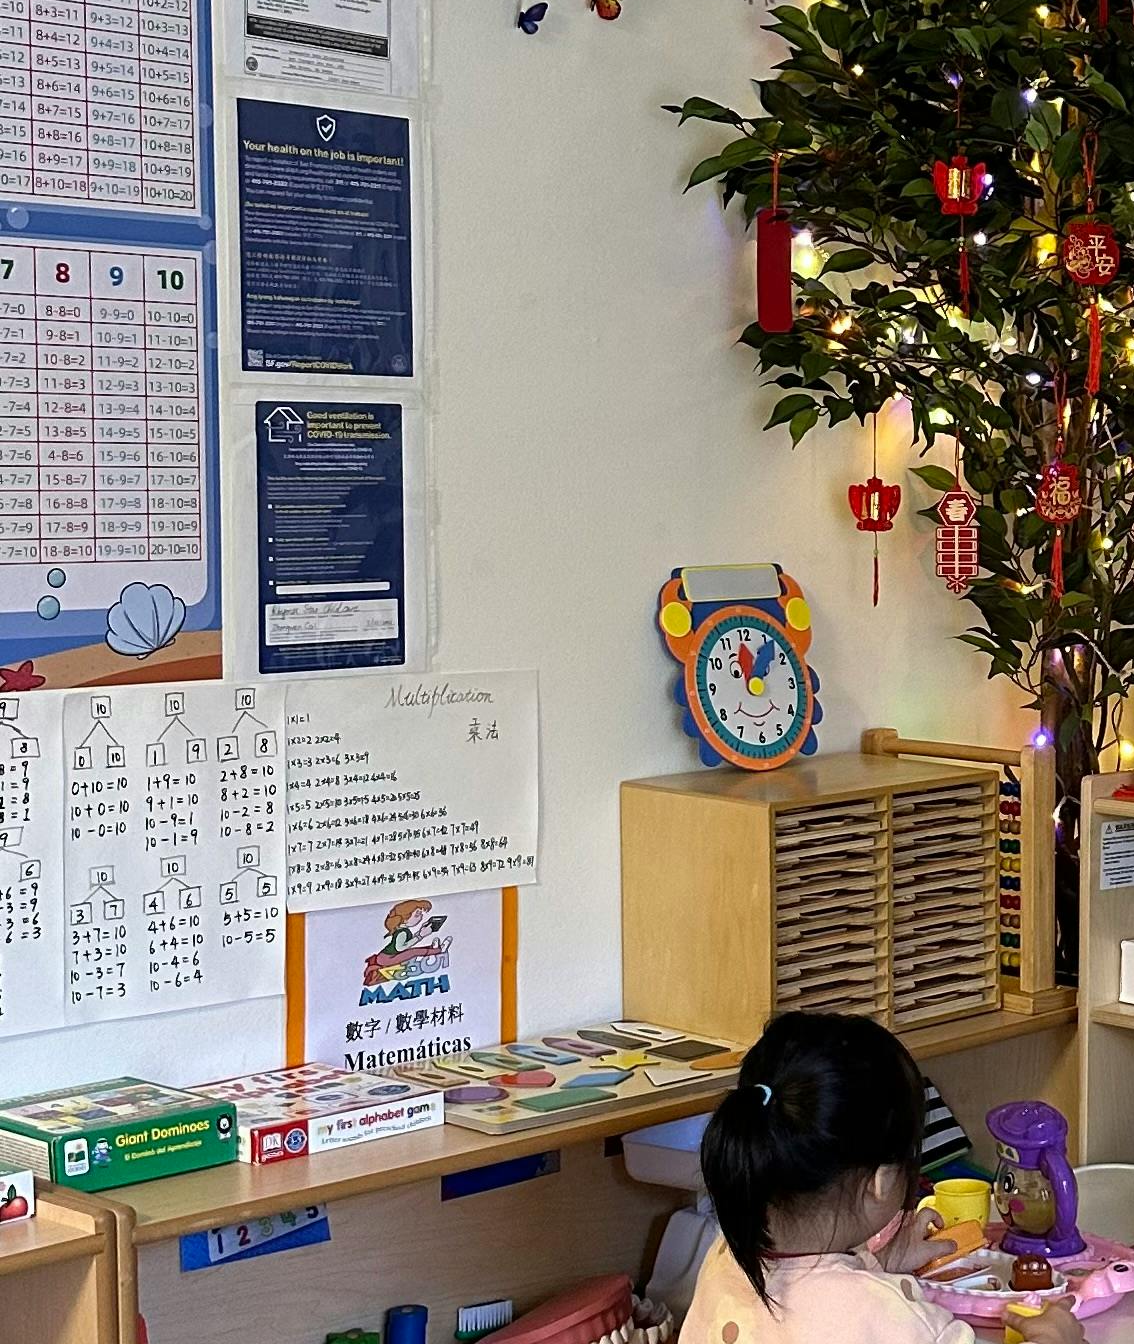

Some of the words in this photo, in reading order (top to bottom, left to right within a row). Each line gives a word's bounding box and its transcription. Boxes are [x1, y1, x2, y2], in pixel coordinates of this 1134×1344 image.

[36, 4, 78, 21] 8+3=11
[36, 29, 80, 46] 8+4=12
[36, 54, 80, 70] 8+5=13
[36, 78, 80, 94] 8+6=14
[38, 103, 82, 119] 8+7=15
[38, 128, 82, 143] 8+8=16
[38, 152, 82, 168] 8+9=17
[244, 140, 266, 151] Your
[268, 142, 298, 154] health
[300, 148, 312, 156] on
[314, 148, 329, 158] the
[330, 150, 346, 160] job
[347, 152, 356, 161] is
[356, 152, 404, 166] important!
[35, 176, 86, 192] 8+10=18
[1088, 234, 1116, 276] 平安
[0, 258, 14, 280] 7
[55, 262, 70, 284] 8
[109, 266, 124, 286] 9
[157, 270, 184, 290] 10
[148, 310, 194, 324] 10-10=0
[150, 358, 194, 370] 12-10=2
[150, 404, 196, 416] 14-10=4
[150, 452, 196, 463] 16-10=6
[1049, 476, 1071, 507] 福
[151, 497, 197, 509] 18-10=8
[945, 498, 968, 522] 春
[150, 542, 198, 555] 20-10=10
[736, 628, 751, 642] 12
[720, 638, 732, 650] 11
[709, 657, 722, 670] 10
[779, 652, 786, 666] 2
[708, 683, 716, 696] 9
[788, 678, 796, 690] 3
[384, 683, 494, 719] Multiplication
[720, 708, 728, 722] 8
[787, 704, 794, 716] 4
[737, 726, 744, 738] 7
[759, 731, 766, 744] 6
[776, 724, 784, 736] 5
[359, 974, 450, 1007] MATH
[346, 1018, 382, 1043] 數字
[395, 1002, 464, 1034] 數學材料
[344, 1036, 472, 1072] Matemáticas
[359, 1108, 404, 1130] alphabet
[116, 1131, 149, 1148] Giant
[152, 1120, 210, 1140] Dominoes
[264, 1138, 280, 1149] DK
[236, 1224, 252, 1246] 2
[258, 1217, 274, 1237] 3
